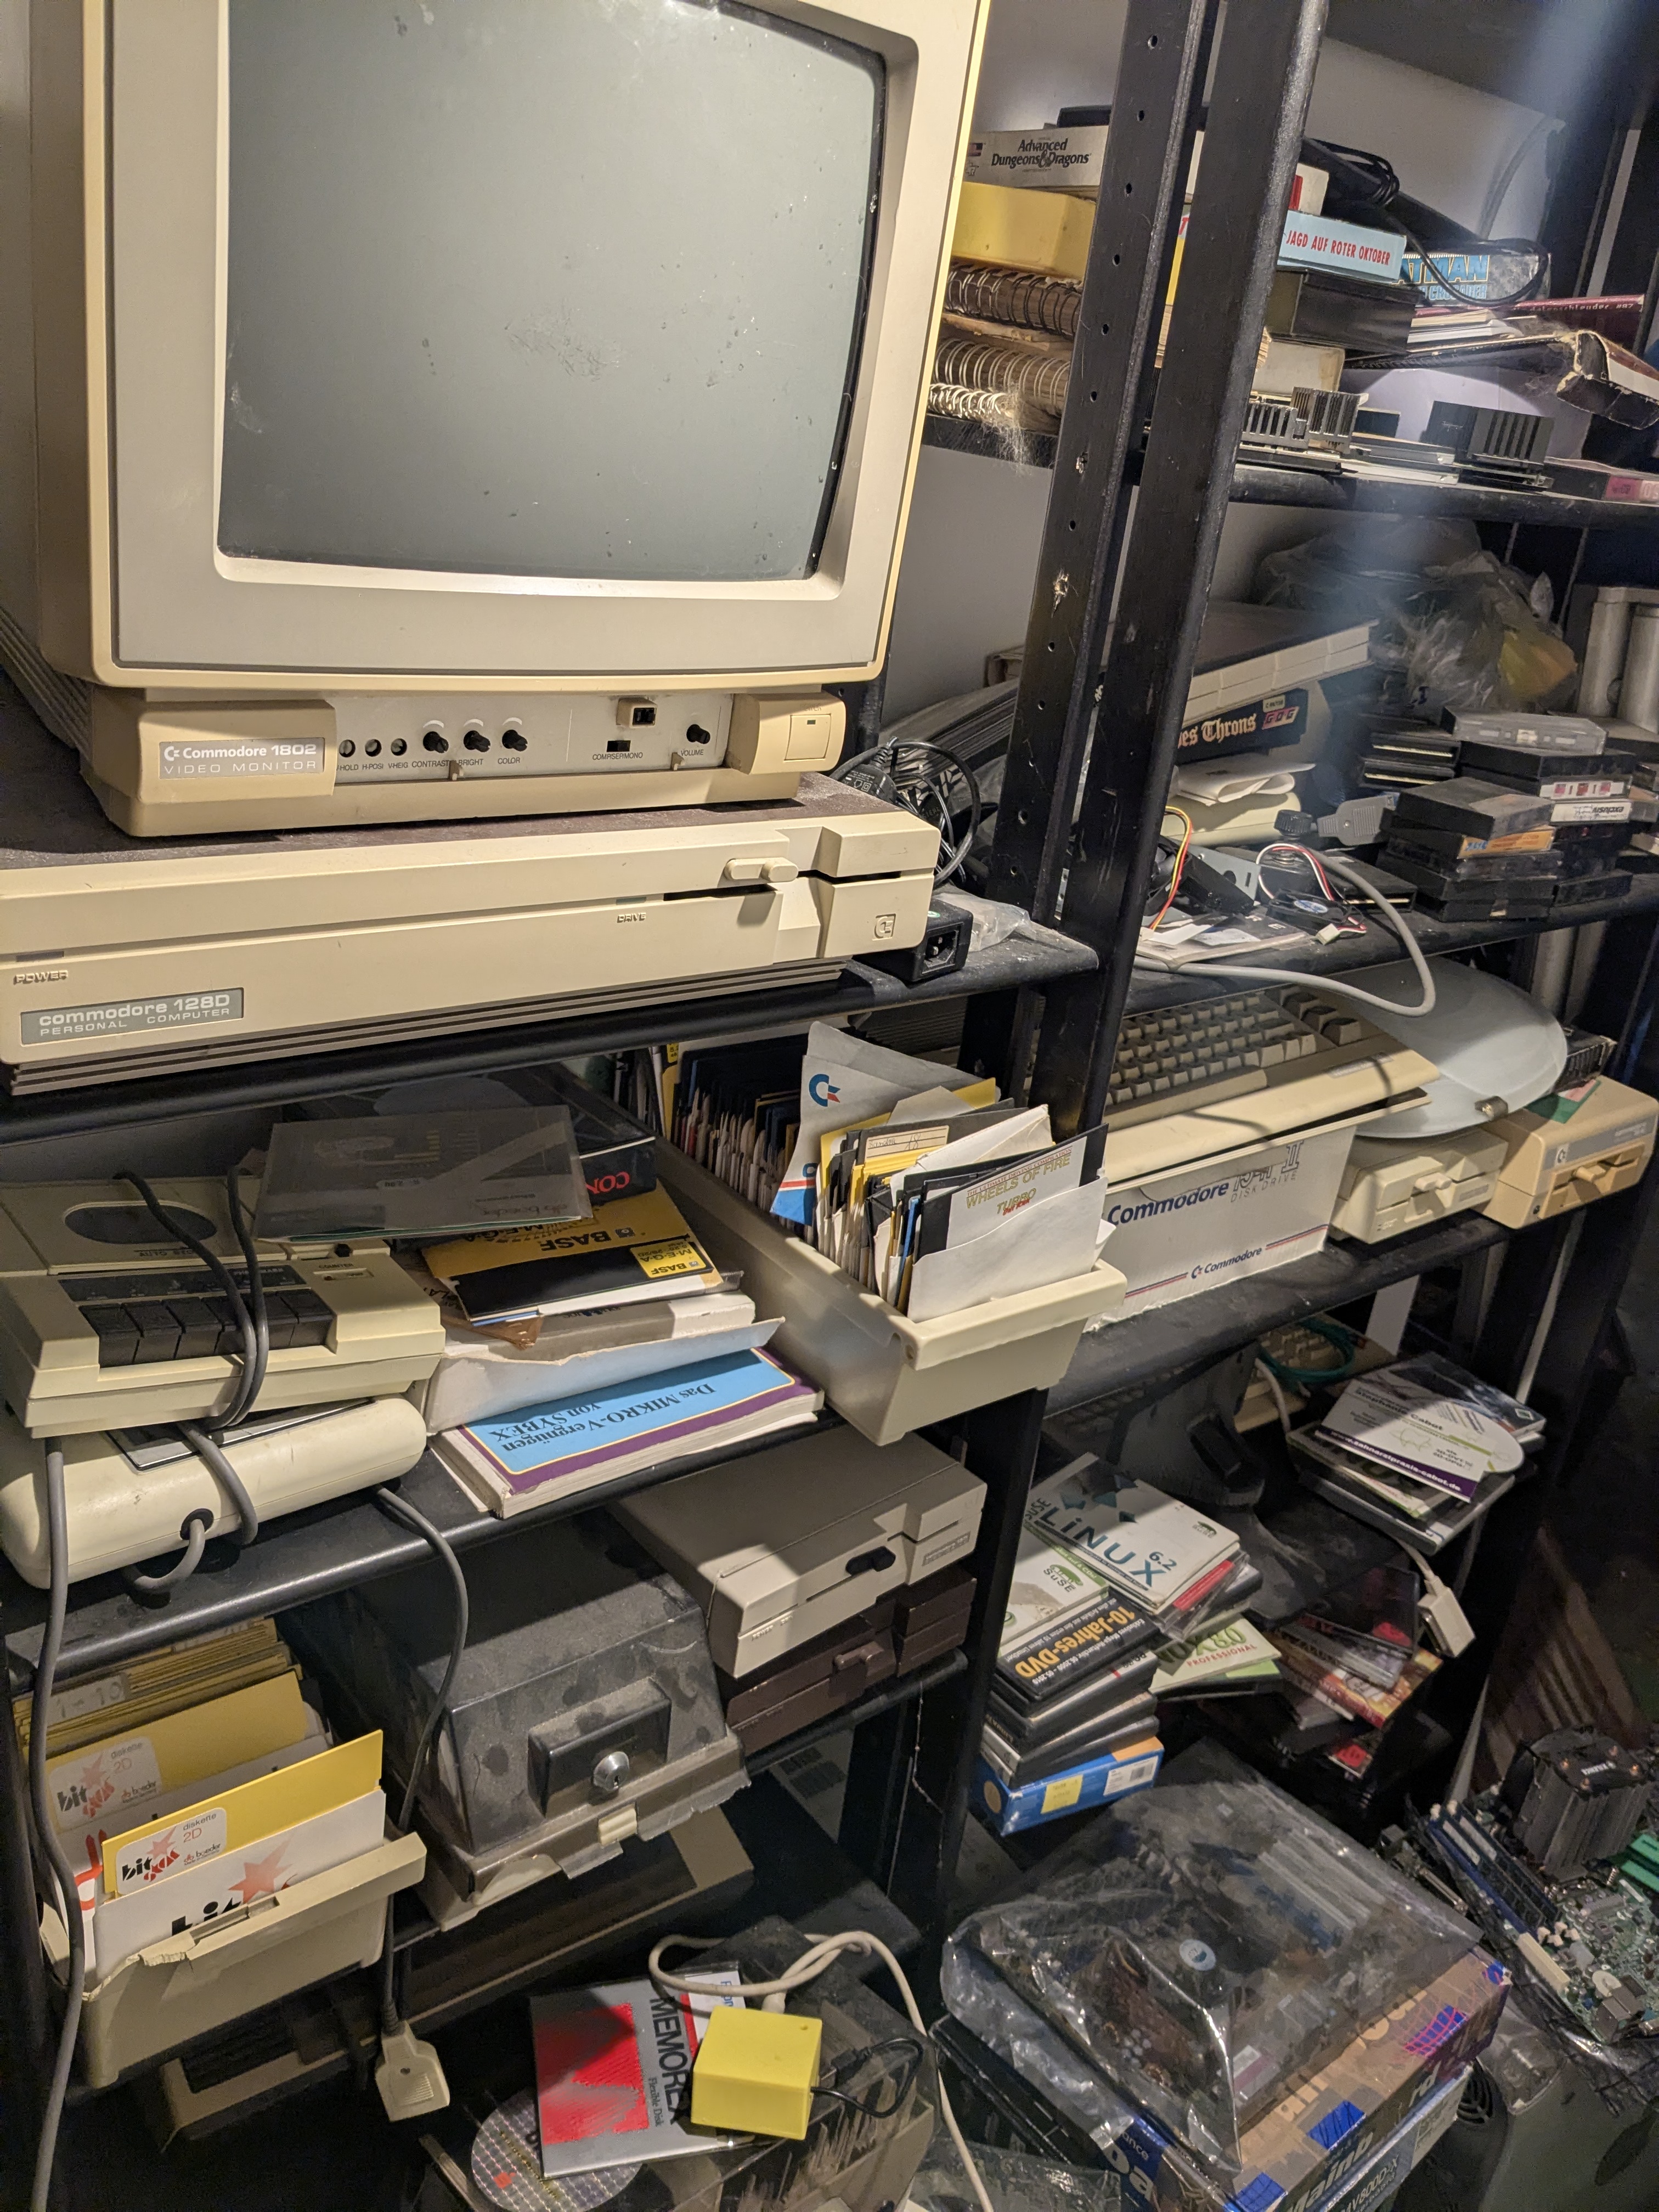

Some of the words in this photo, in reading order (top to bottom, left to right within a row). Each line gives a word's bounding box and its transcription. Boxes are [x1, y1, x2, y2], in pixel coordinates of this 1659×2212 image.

[1017, 138, 1069, 152] Advanced
[991, 153, 1040, 169] Dungeons
[1048, 153, 1090, 167] Dragons
[1286, 230, 1308, 247] JAGD
[1311, 235, 1329, 252] AUF
[1330, 240, 1356, 258] ROTER
[1359, 246, 1391, 266] OKTOBER
[1392, 255, 1490, 285] ATMAN
[1201, 713, 1257, 743] Throns
[183, 746, 267, 759] Commodore
[271, 743, 317, 756] 1802
[163, 764, 221, 774] VIDEO
[232, 761, 316, 772] MONITOR
[411, 760, 450, 768] CONTRAST
[459, 758, 483, 766] BRIGHT
[498, 757, 521, 765] COLOR
[617, 912, 647, 923] DRIVE
[13, 970, 69, 985] POWER
[40, 1003, 167, 1026] commodore
[173, 994, 230, 1011] 128D
[40, 1020, 127, 1036] PERSONAL
[146, 1008, 230, 1024] COMPUTER
[979, 1176, 1007, 1192] ULTIMATE
[1008, 1165, 1033, 1178] DRIVING
[1034, 1148, 1073, 1167] COMPILATION
[966, 1177, 1019, 1209] WHEELS
[1023, 1166, 1041, 1184] OF
[1043, 1154, 1071, 1176] FIRE
[1231, 1186, 1256, 1203] DISK
[1262, 1170, 1297, 1191] DRIVE
[996, 1188, 1036, 1215] TURBO
[1108, 1182, 1229, 1226] Commodore
[539, 1230, 612, 1251] BASF
[651, 1262, 687, 1276] BASF
[1204, 1247, 1262, 1274] Commodore
[679, 1383, 717, 1399] Das
[566, 1402, 602, 1418] von
[489, 1414, 567, 1442] SYBEX
[501, 1394, 681, 1452] MIKRO-Vergnügen
[1410, 1414, 1443, 1431] Cabot
[1149, 1551, 1177, 1571] 6.2
[1043, 1567, 1076, 1593] SuSE
[1014, 1606, 1136, 1678] 10-Jahres-DVD
[1186, 1644, 1258, 1668] PROFESSIONAL
[112, 1758, 133, 1773] 2D
[57, 1785, 88, 1812] bit
[132, 1780, 156, 1795] boeder
[183, 1813, 217, 1831] diskette
[183, 1827, 202, 1843] 2D
[196, 1843, 221, 1858] boeder
[122, 1857, 153, 1882] bit
